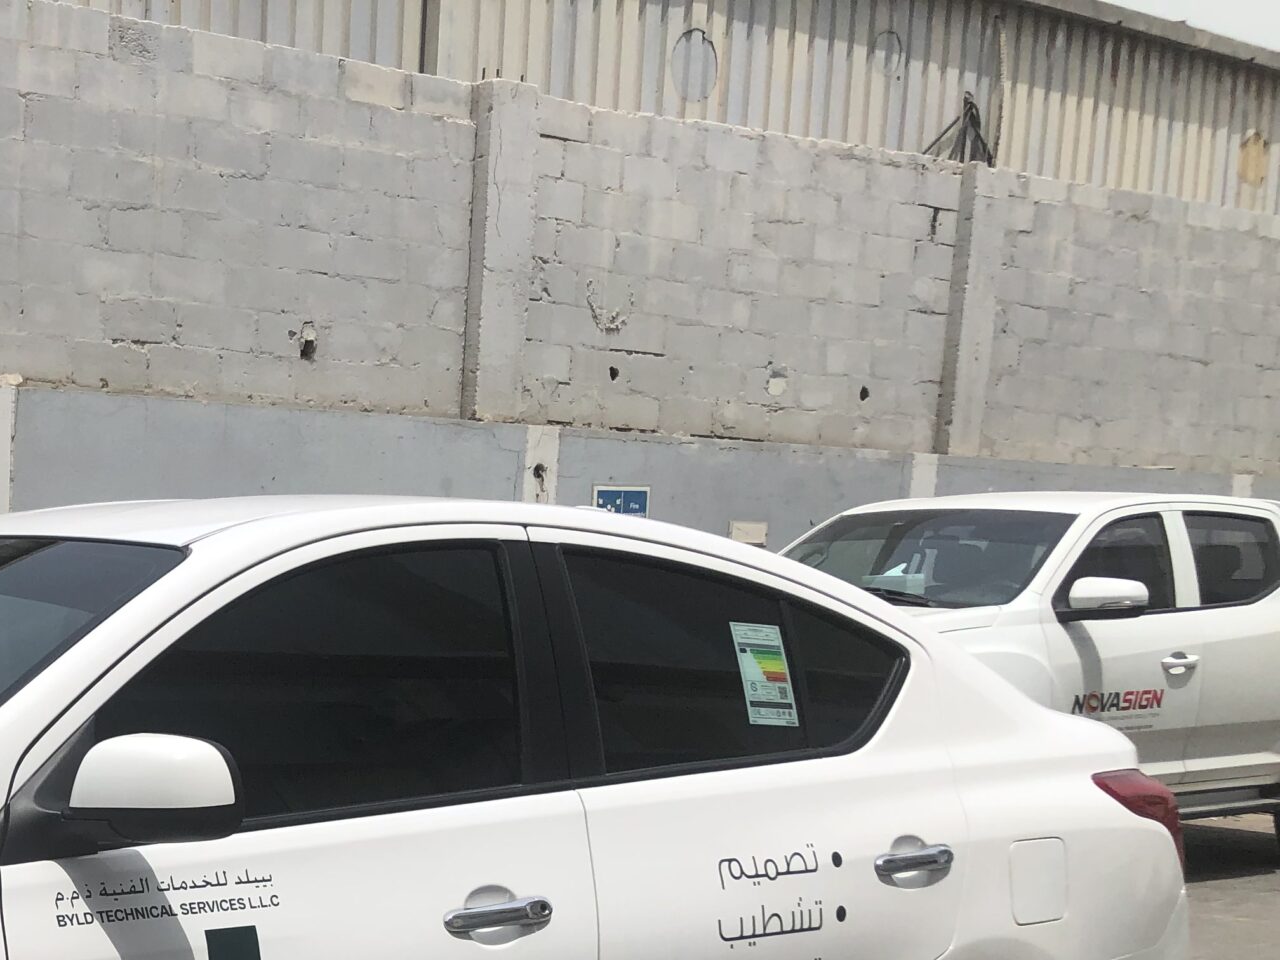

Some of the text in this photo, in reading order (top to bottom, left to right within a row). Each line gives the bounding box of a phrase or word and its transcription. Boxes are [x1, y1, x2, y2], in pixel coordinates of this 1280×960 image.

[1072, 689, 1164, 714] NOVASIGN
[718, 843, 819, 890] تصميم
[99, 877, 150, 901] الفنية
[156, 870, 228, 892] للخدمات
[56, 911, 95, 928] BYLD
[96, 903, 178, 924] TECHNICAL
[179, 897, 247, 916] SERVICES
[718, 897, 823, 949] تشطيب
